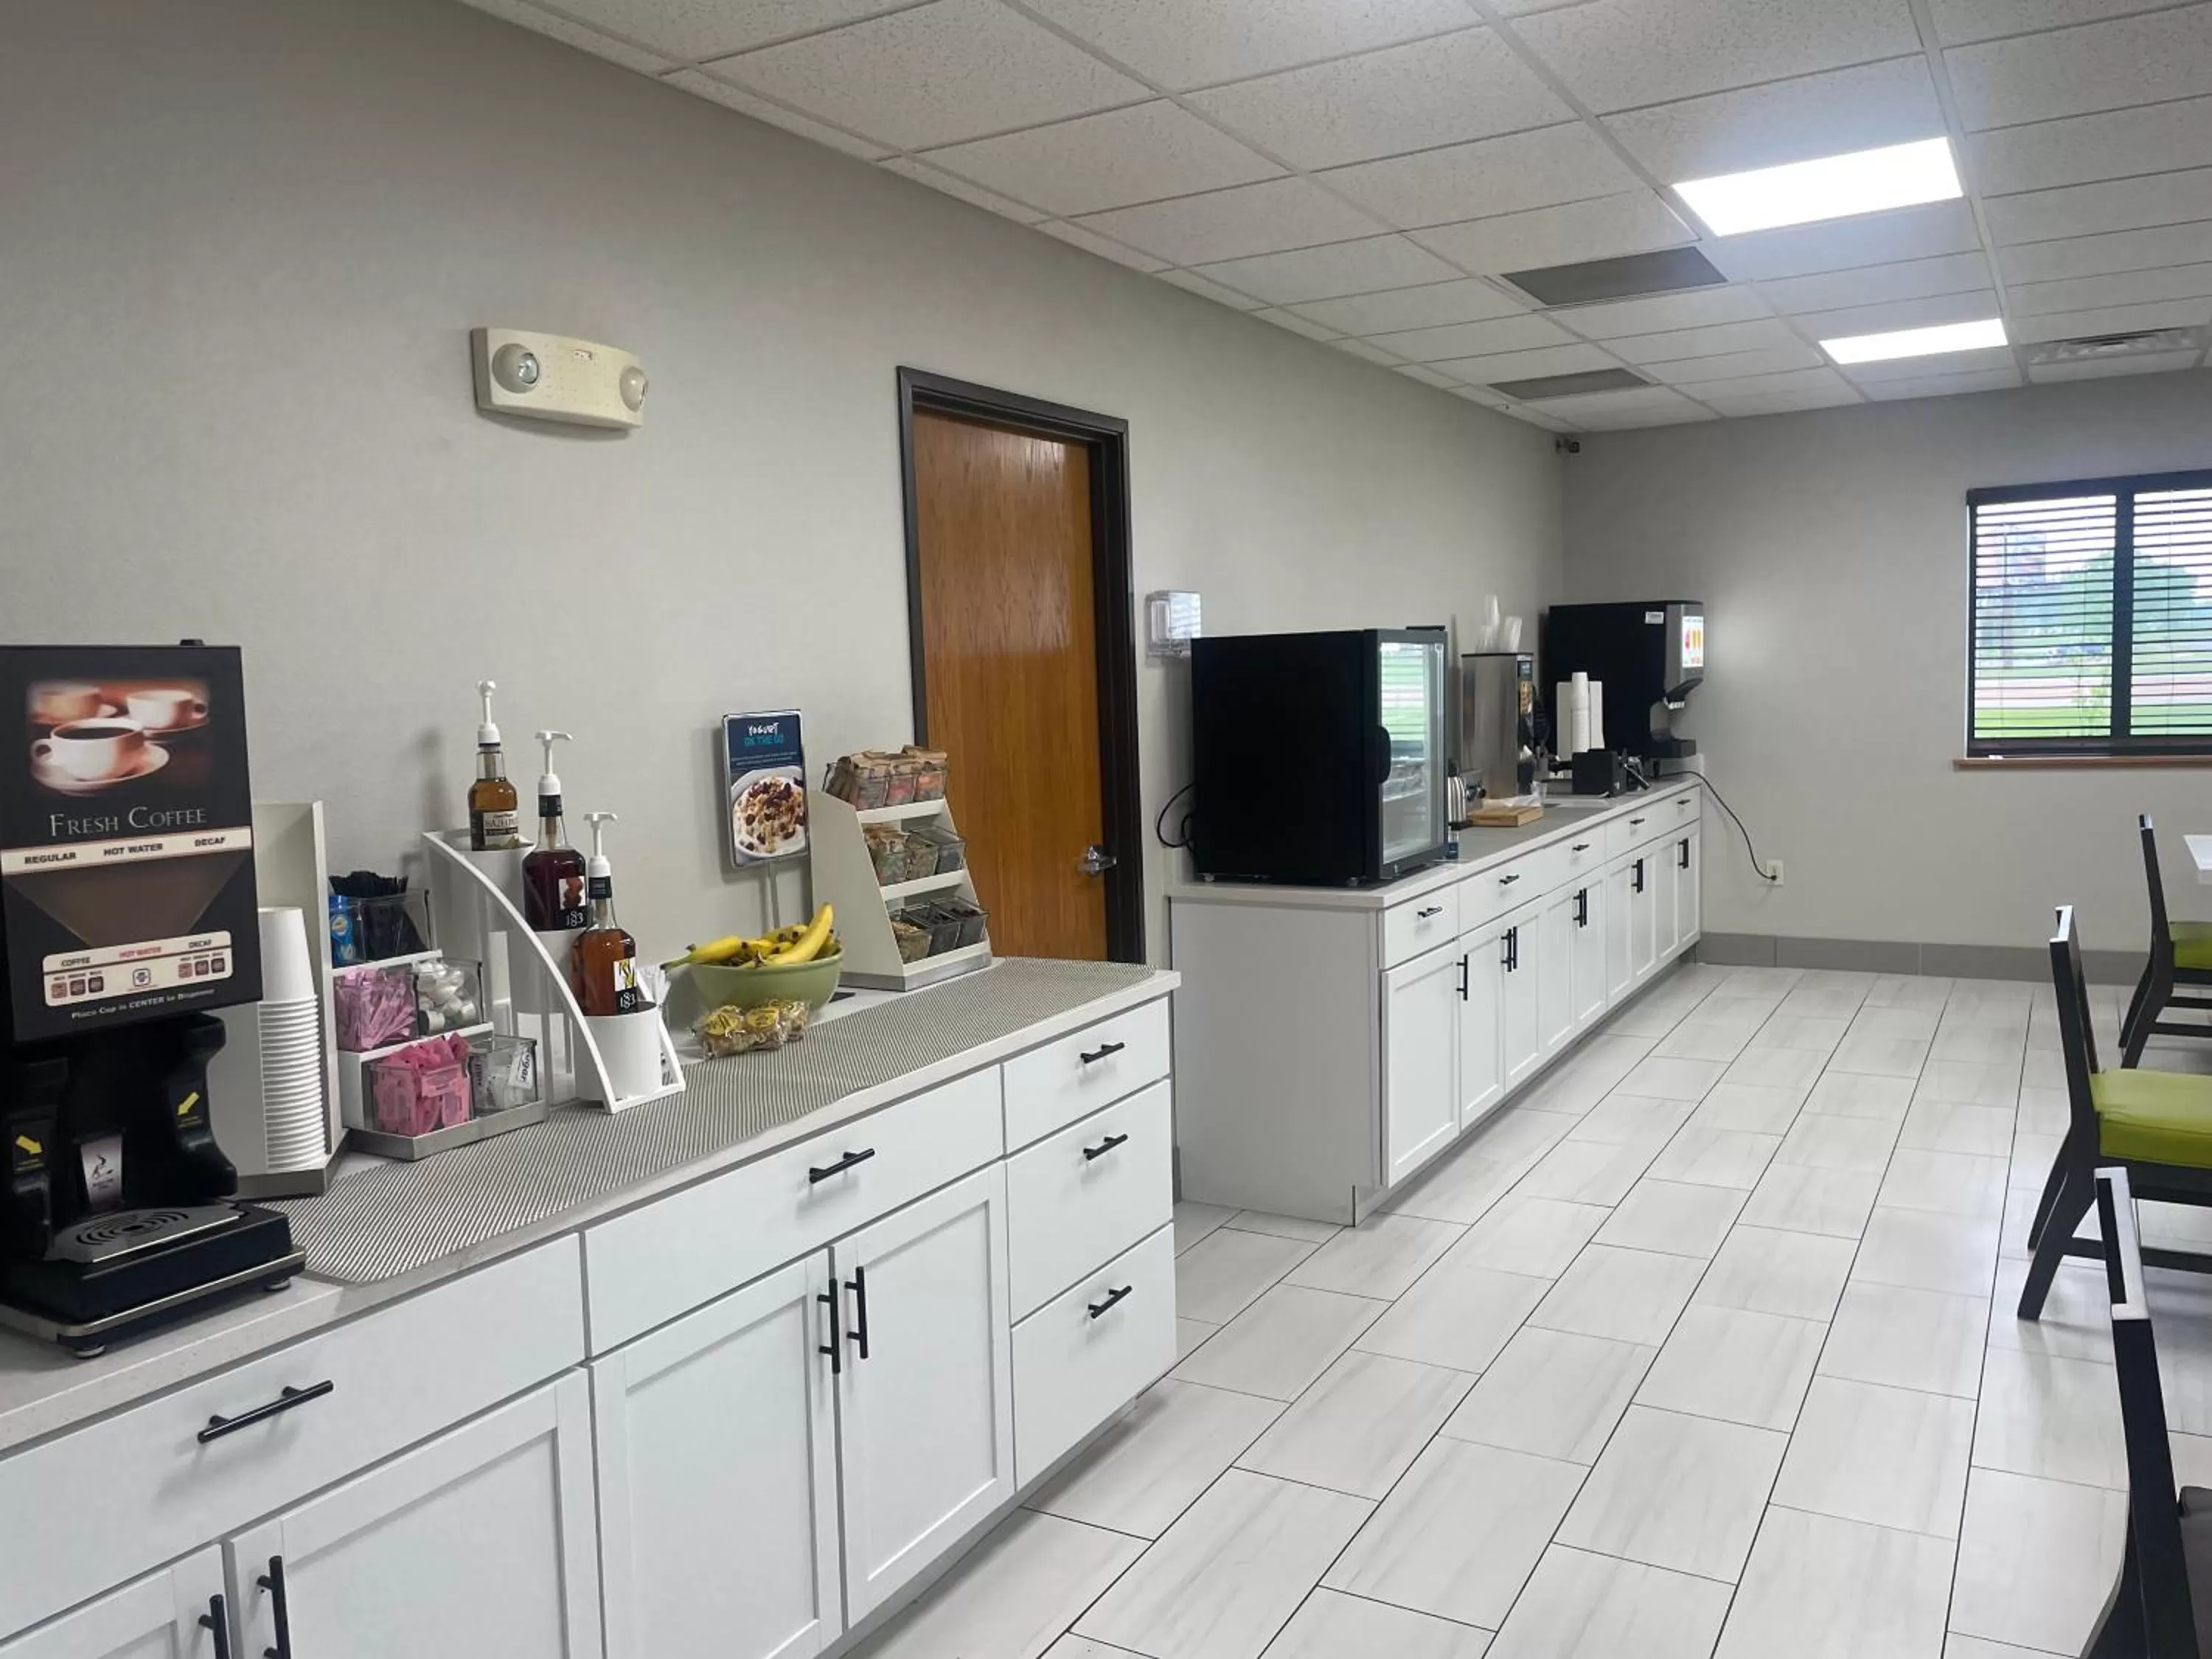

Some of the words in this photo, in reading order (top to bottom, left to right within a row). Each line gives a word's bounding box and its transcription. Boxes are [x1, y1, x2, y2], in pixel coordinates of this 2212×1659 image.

[748, 722, 779, 737] YOGURT
[194, 837, 226, 847] DECAF
[103, 847, 125, 856] HOT
[128, 843, 164, 853] WATER
[24, 852, 76, 864] REGULAR
[566, 910, 583, 927] 1883
[189, 939, 212, 949] DECAF
[136, 946, 161, 956] WATER
[61, 957, 90, 967] COFFEE
[99, 1006, 116, 1015] Cup
[129, 996, 164, 1008] CENTER
[620, 992, 636, 1009] 1883
